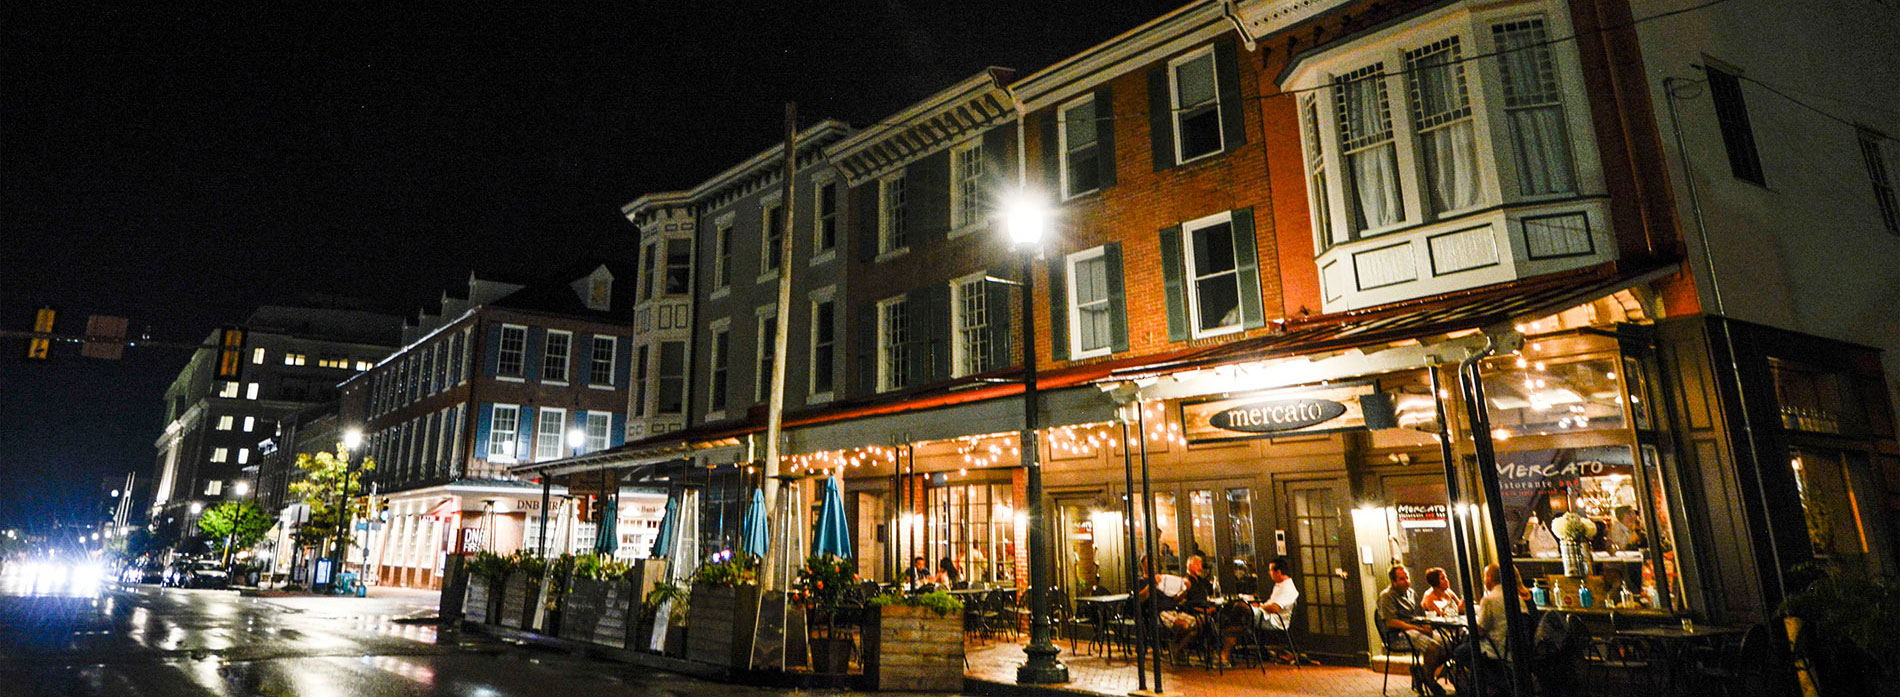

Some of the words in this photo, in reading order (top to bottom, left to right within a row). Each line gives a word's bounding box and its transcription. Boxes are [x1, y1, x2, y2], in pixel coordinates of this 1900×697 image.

[1227, 400, 1323, 427] mercato
[1496, 461, 1603, 479] MERCATO
[1499, 480, 1553, 490] istorante
[516, 499, 540, 510] DNB
